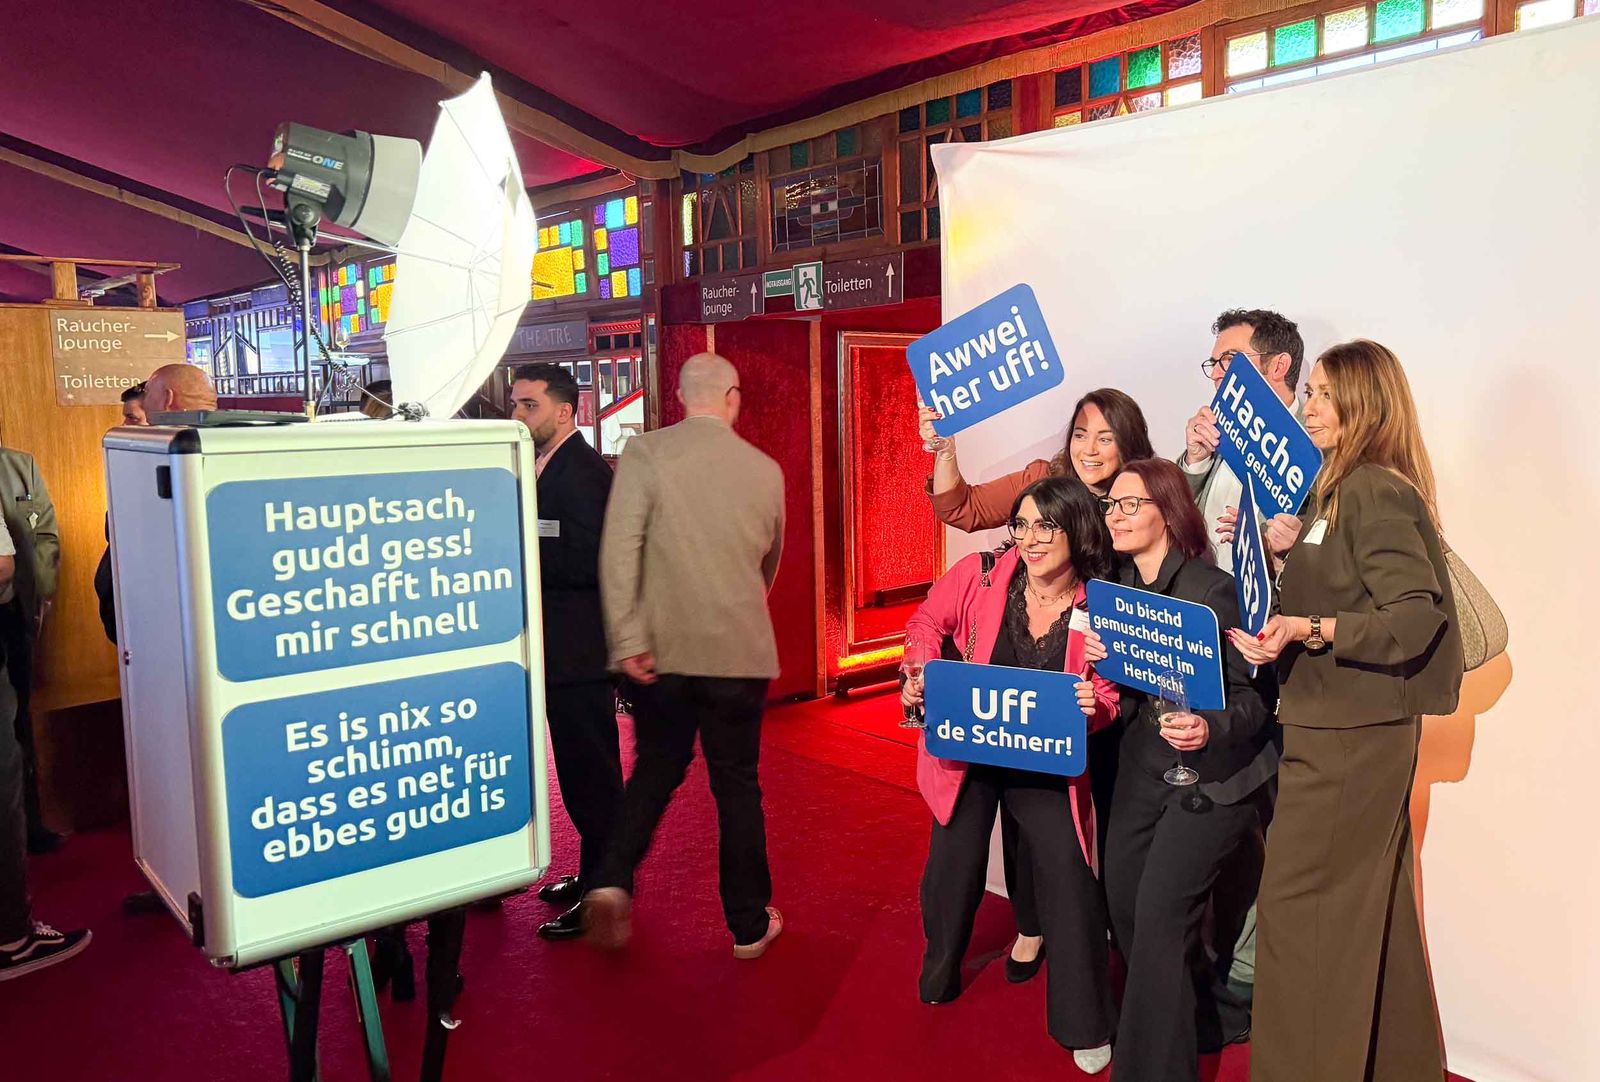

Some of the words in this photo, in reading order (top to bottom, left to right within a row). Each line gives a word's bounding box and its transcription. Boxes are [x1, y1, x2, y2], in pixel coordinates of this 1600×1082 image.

[312, 155, 344, 170] ONE
[702, 285, 740, 300] Raucher-
[703, 301, 733, 317] lounge
[825, 277, 872, 294] Toiletten
[56, 318, 137, 333] Raucher-
[58, 334, 122, 353] lounge
[929, 305, 1028, 384] Awwei
[929, 377, 981, 420] her
[988, 340, 1049, 392] uff!
[1213, 401, 1249, 455] huddel
[1245, 452, 1294, 513] gehadd?
[1221, 373, 1304, 494] Hasche
[265, 488, 475, 533] Hauptsach,
[272, 534, 369, 581] gudd
[381, 528, 473, 570] gess!
[1236, 511, 1260, 630] Hä?
[226, 570, 420, 621] Geschafft
[430, 566, 513, 597] hann
[1115, 597, 1134, 614] Du
[1137, 601, 1182, 628] bischd
[275, 620, 340, 658] mir
[351, 600, 479, 648] schnell
[1093, 615, 1183, 650] gemuschderd
[1187, 640, 1213, 659] wie
[1113, 641, 1127, 655] et
[1129, 644, 1174, 669] Gretel
[1176, 656, 1195, 676] im
[286, 721, 329, 752] Es
[339, 712, 368, 742] is
[379, 701, 431, 735] nix
[440, 698, 478, 724] so
[972, 687, 1037, 724] Uff
[307, 735, 463, 784] schlimm,
[937, 720, 965, 741] de
[971, 724, 1072, 756] Schnerr!
[251, 791, 337, 830] dass
[347, 780, 387, 809] es
[397, 763, 455, 799] net
[464, 751, 512, 785] für
[263, 817, 376, 863] ebbes
[386, 787, 471, 841] gudd
[481, 784, 506, 813] is
